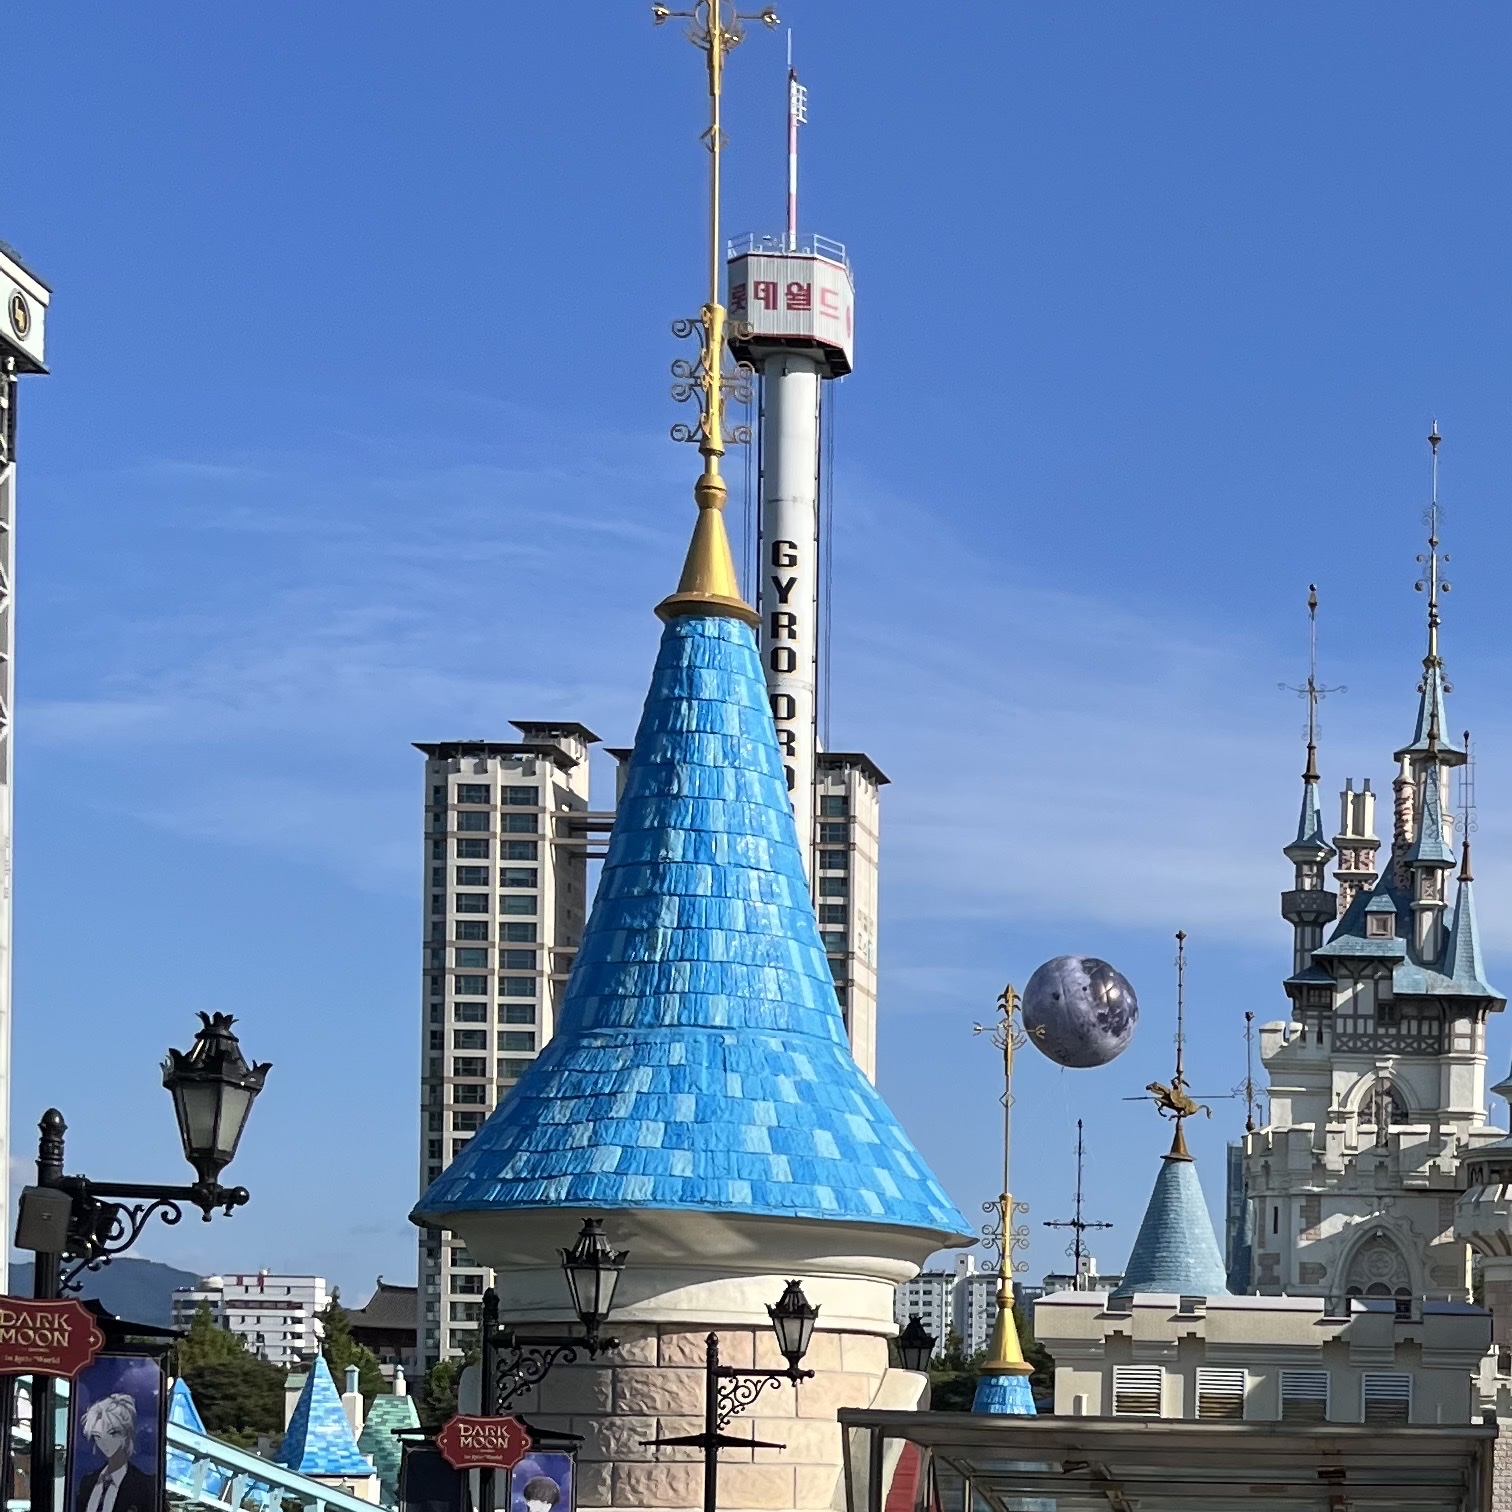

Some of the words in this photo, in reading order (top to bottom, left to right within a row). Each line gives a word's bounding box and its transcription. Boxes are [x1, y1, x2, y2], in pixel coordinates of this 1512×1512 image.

[732, 280, 840, 320] 롯데월드
[770, 540, 798, 673] GYRO
[0, 1310, 72, 1331] DARK
[0, 1328, 69, 1347] MOON
[459, 1424, 510, 1438] DARK
[459, 1436, 509, 1449] MOON
